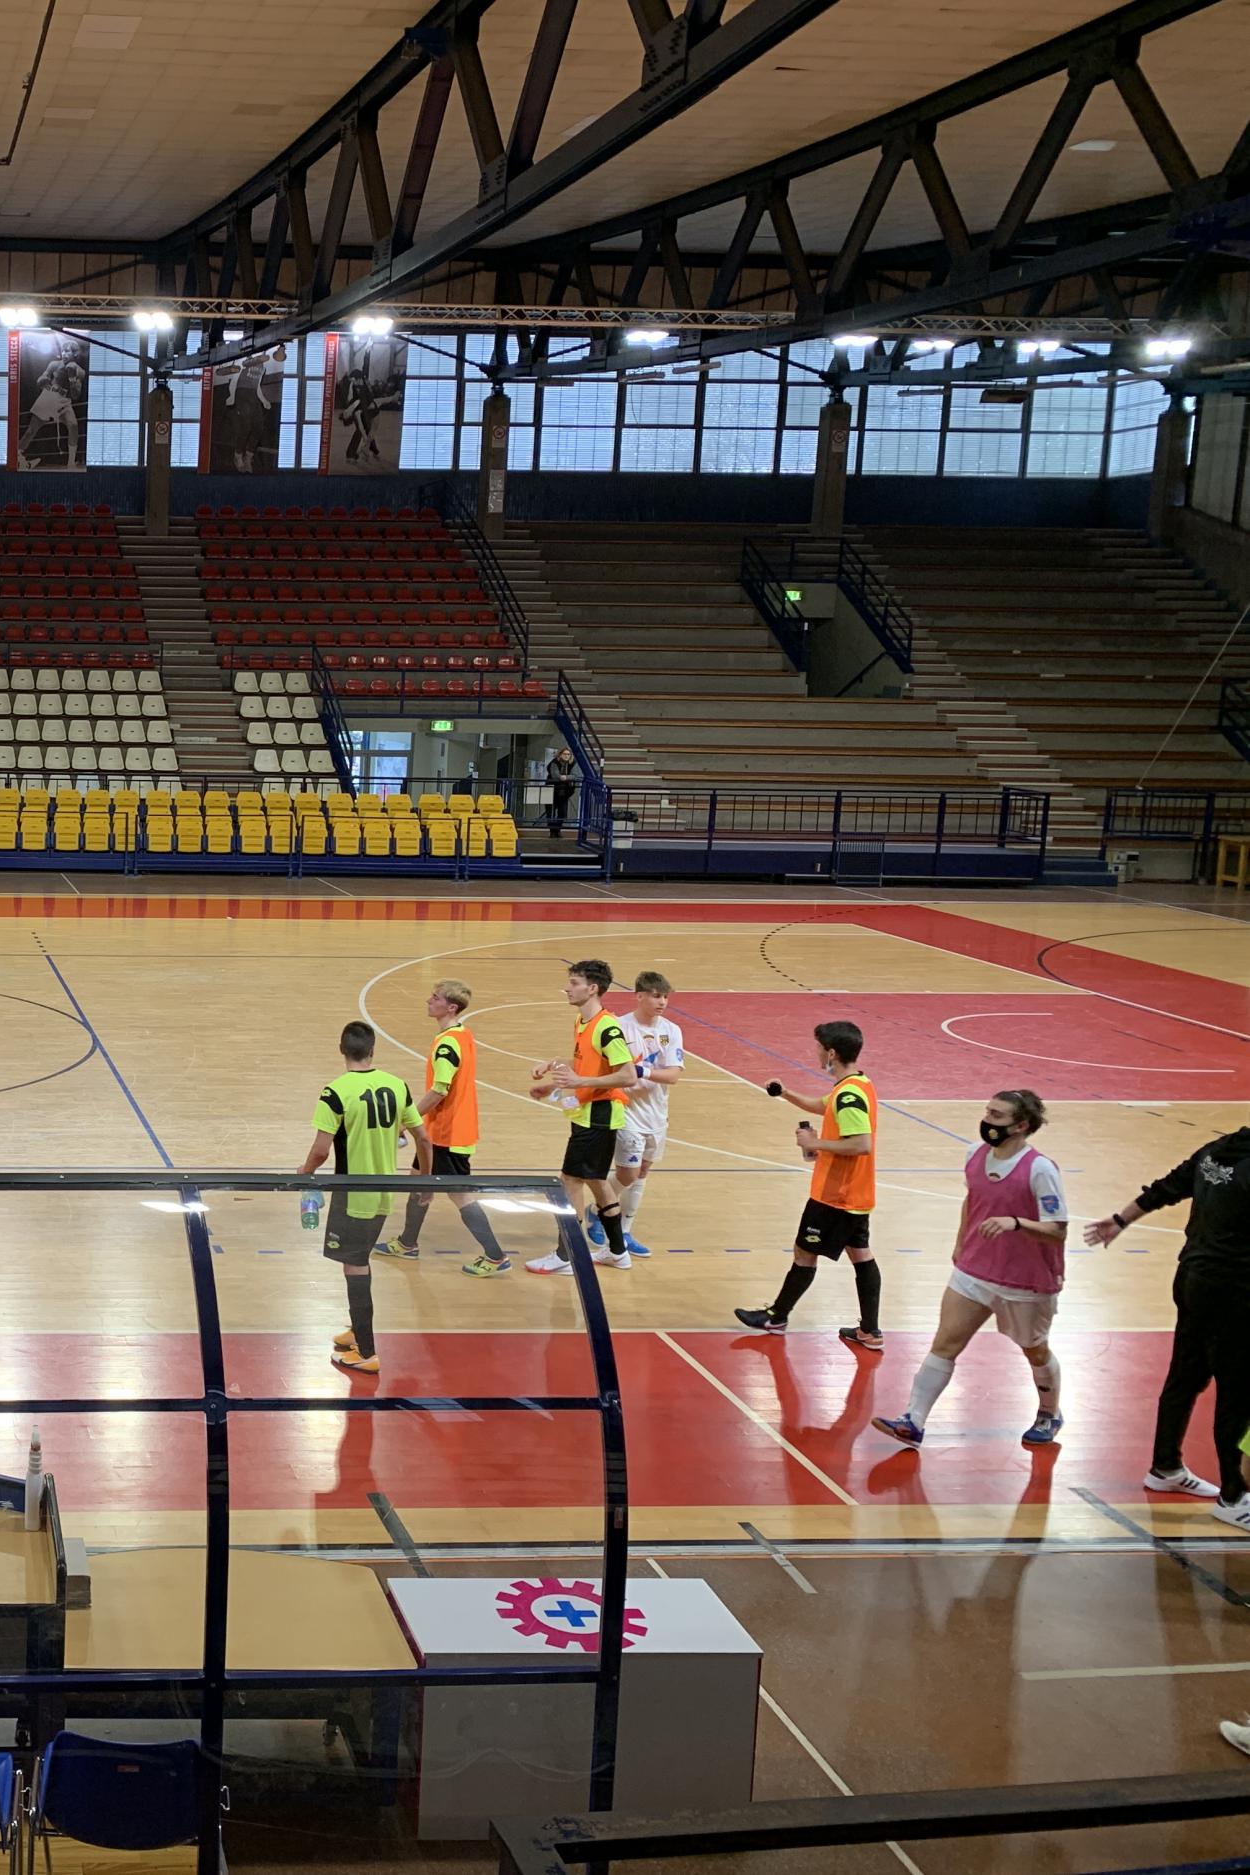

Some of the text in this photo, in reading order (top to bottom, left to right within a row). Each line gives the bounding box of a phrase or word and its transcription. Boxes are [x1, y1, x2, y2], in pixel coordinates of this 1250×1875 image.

[9, 336, 18, 383] LORIS STECCA
[359, 1086, 397, 1130] 10
